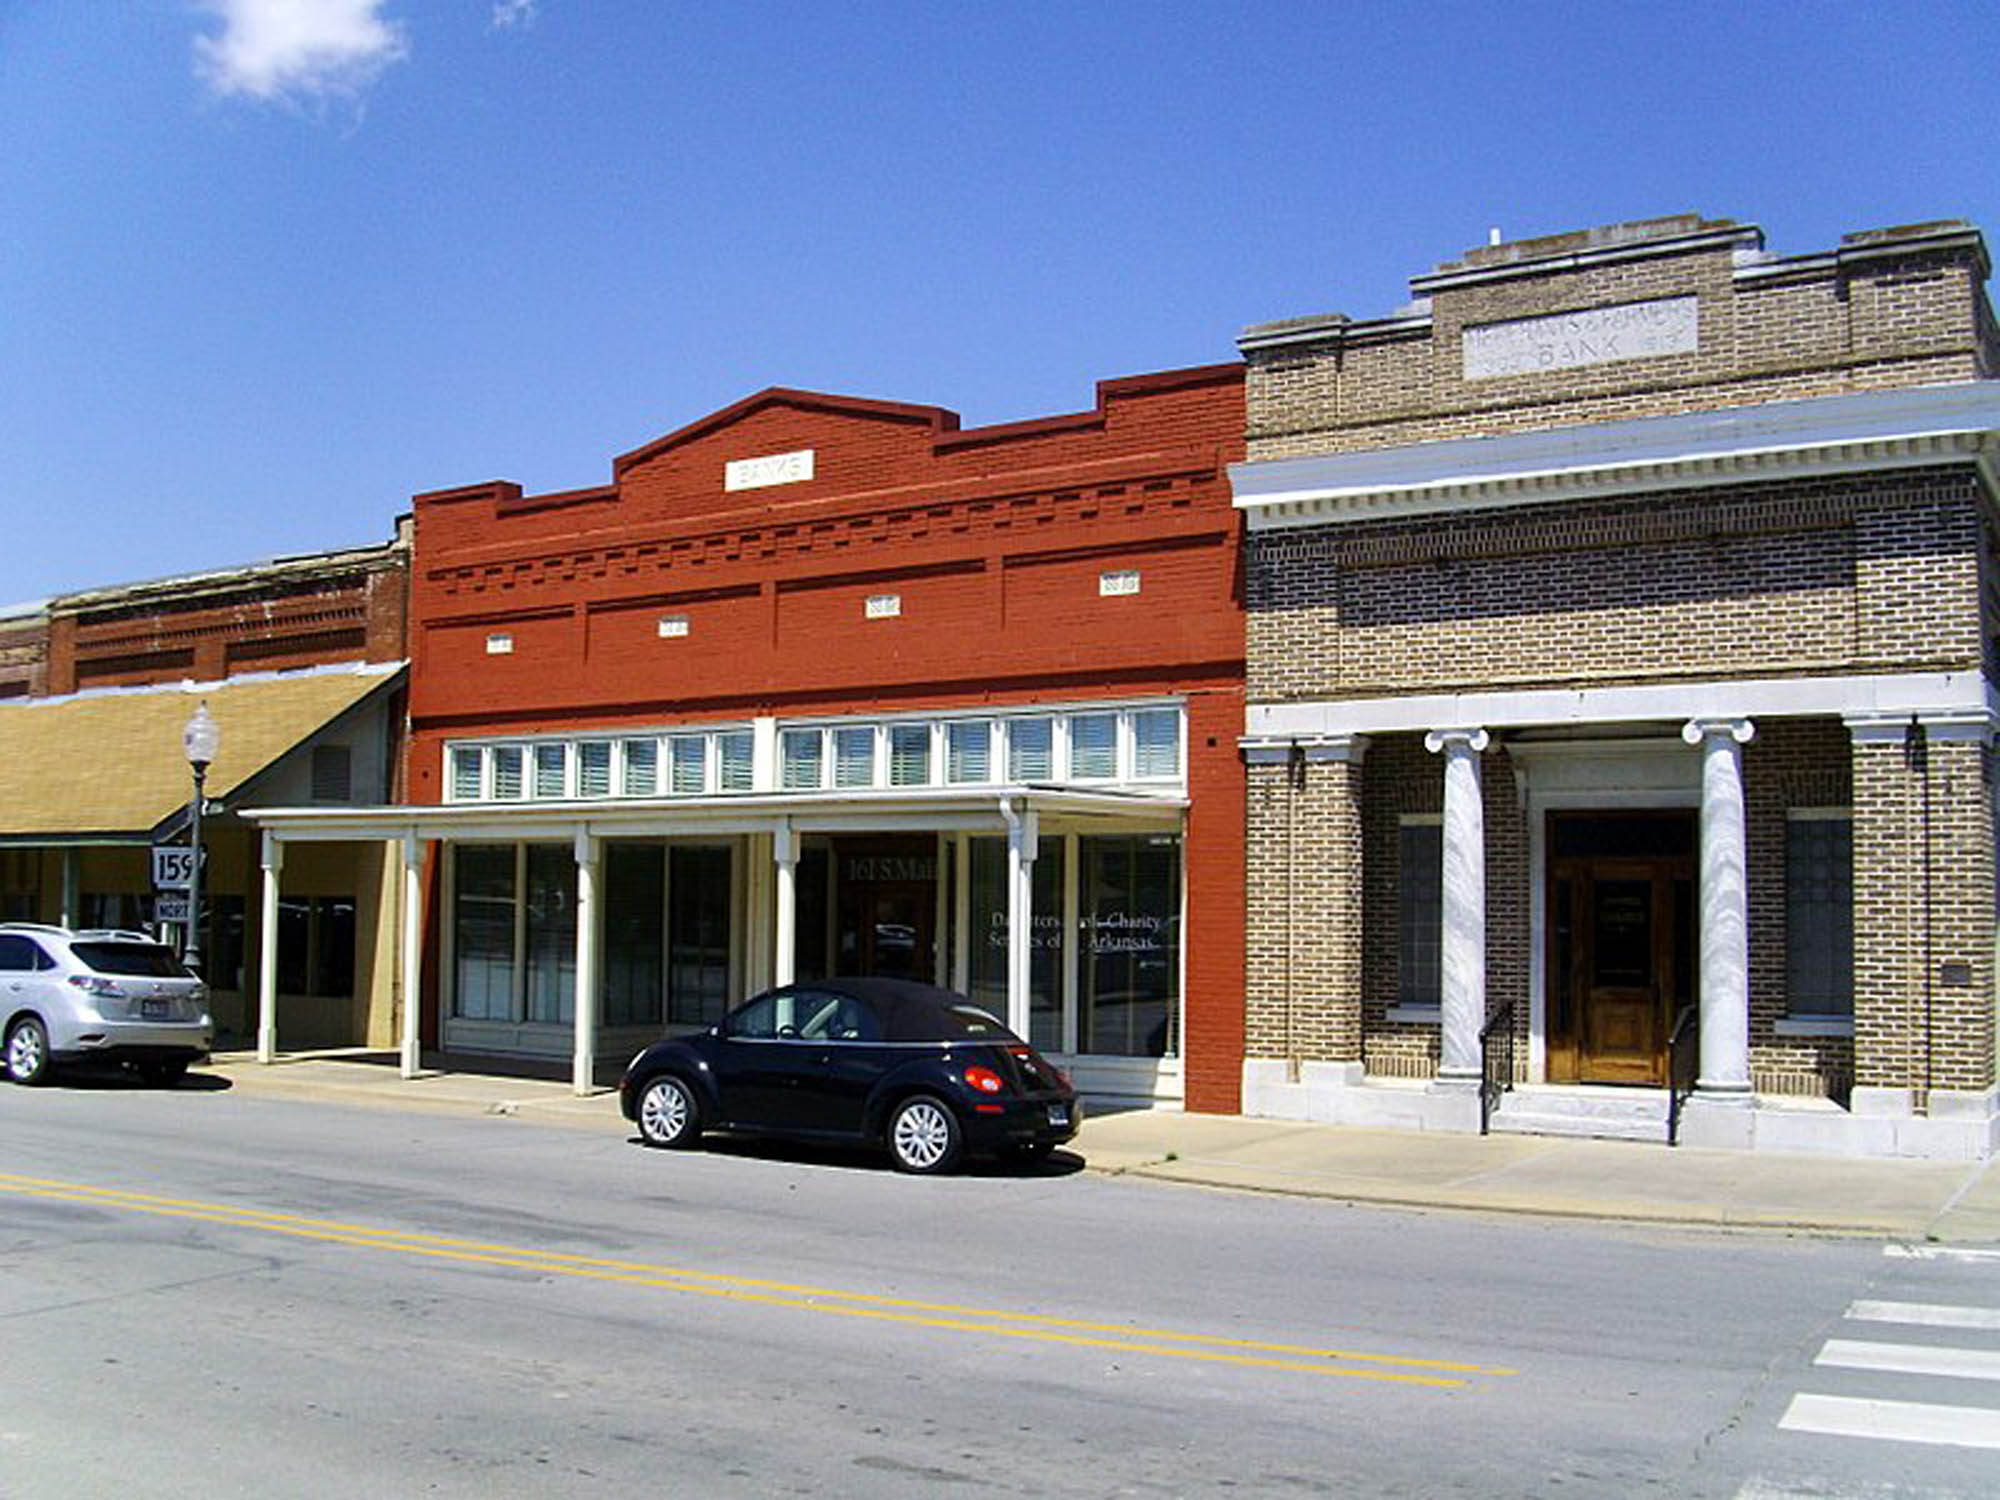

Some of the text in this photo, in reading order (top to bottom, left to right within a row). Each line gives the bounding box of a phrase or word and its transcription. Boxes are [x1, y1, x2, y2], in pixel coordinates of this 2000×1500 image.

[1538, 334, 1619, 365] BANK
[158, 853, 192, 881] 159
[896, 862, 938, 881] Mai
[159, 903, 190, 918] NORT
[991, 911, 1061, 929] Daters
[1106, 911, 1160, 933] Charity
[1089, 931, 1153, 949] Arkansas
